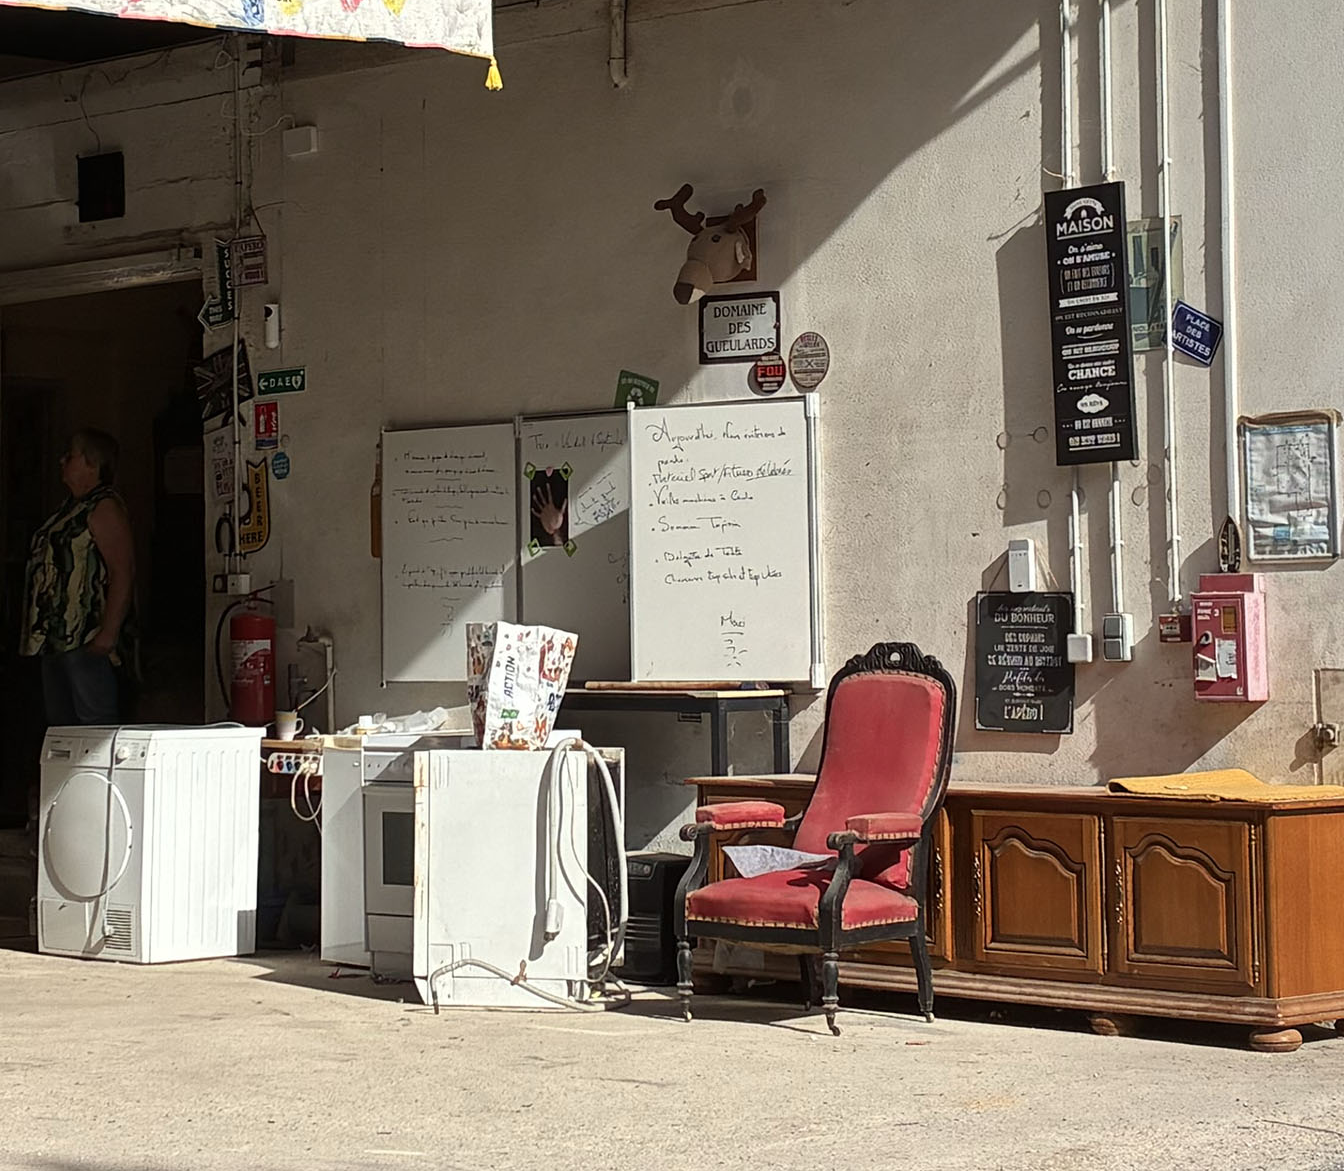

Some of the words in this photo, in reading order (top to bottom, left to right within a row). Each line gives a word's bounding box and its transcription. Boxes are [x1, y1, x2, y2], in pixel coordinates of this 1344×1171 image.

[1056, 214, 1114, 237] MAISON
[713, 302, 767, 319] DOMAINE
[728, 321, 752, 335] DES
[1185, 313, 1211, 333] PLACE
[1185, 325, 1203, 339] DES
[705, 337, 775, 353] GUEULARDS
[757, 364, 783, 377] FOU
[1068, 365, 1116, 381] CHANCE
[269, 376, 291, 388] DAE
[994, 612, 1009, 623] DU
[1010, 612, 1055, 624] BONHEUR
[503, 655, 516, 699] ACTION
